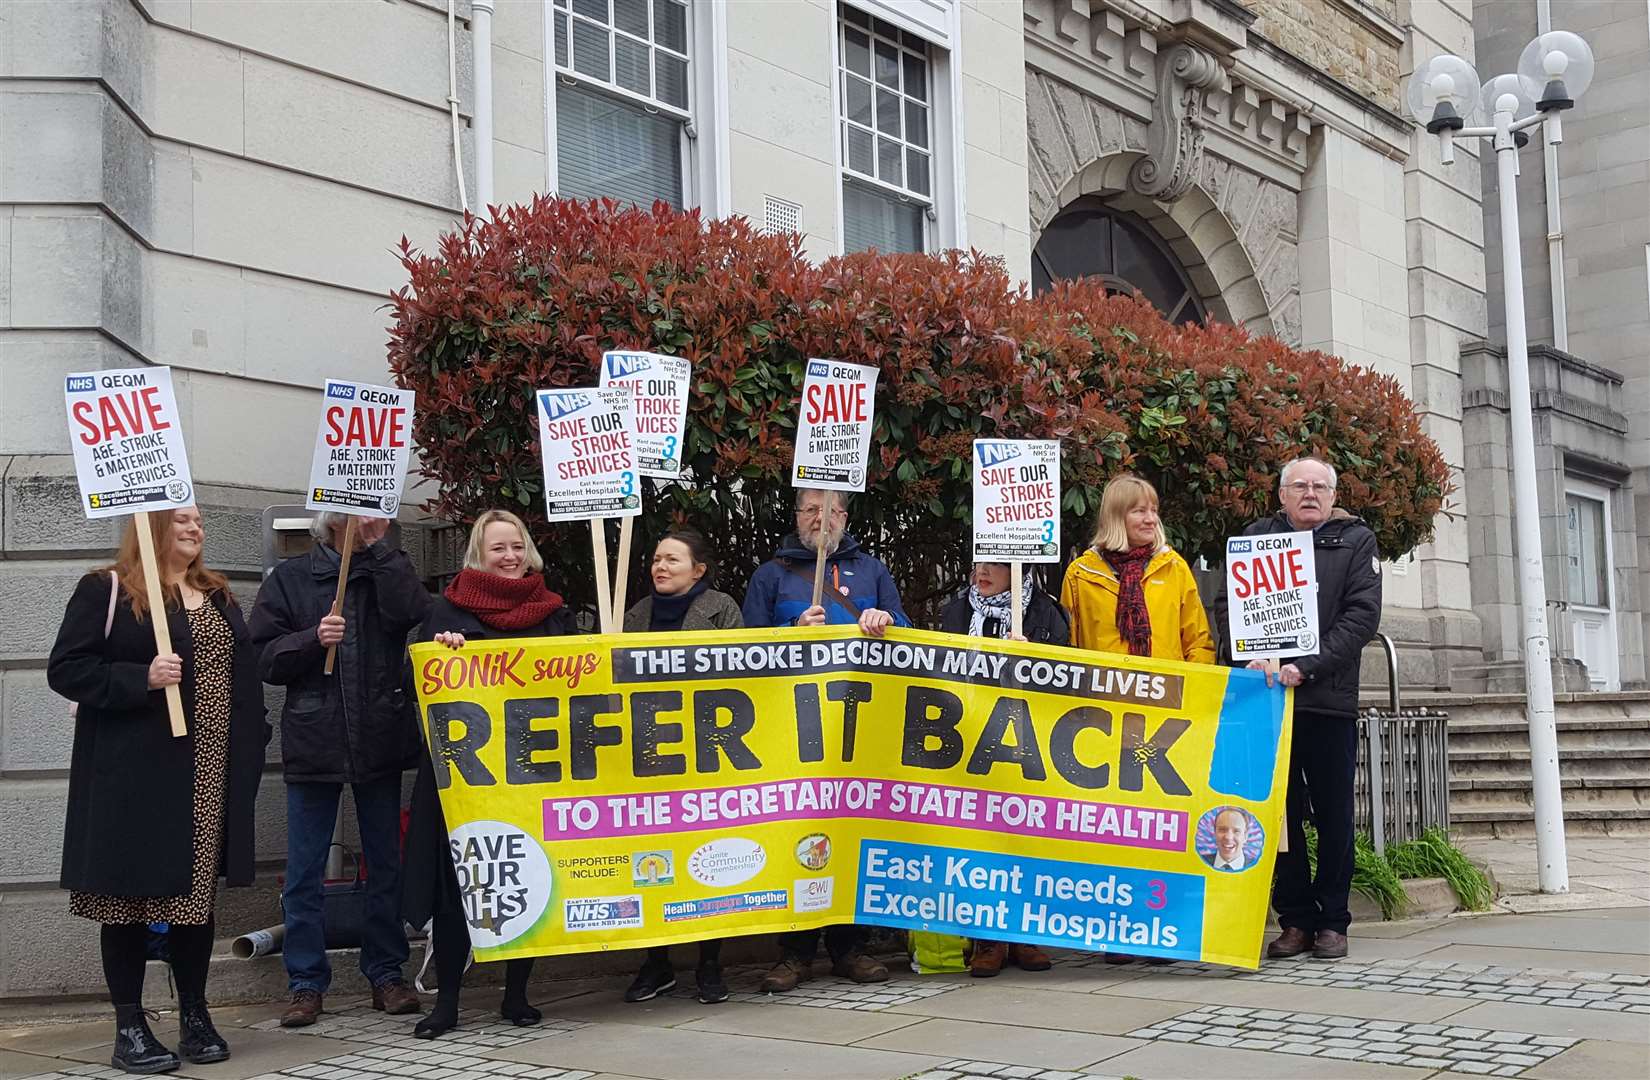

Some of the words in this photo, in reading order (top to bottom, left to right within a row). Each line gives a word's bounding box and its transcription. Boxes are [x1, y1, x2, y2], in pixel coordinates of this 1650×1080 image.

[613, 354, 651, 377] NHS
[659, 358, 674, 366] Save
[663, 365, 678, 374] NHS
[810, 364, 828, 375] NHS
[832, 366, 862, 381] QEQM
[68, 378, 94, 391] NHS
[101, 373, 147, 389] QEQM
[647, 379, 677, 396] OUR
[330, 385, 354, 397] NHS
[360, 389, 400, 406] QEQM
[550, 394, 591, 418] NHS
[806, 383, 867, 425] SAVE
[72, 386, 171, 446] SAVE
[634, 398, 681, 415] TROKE
[325, 405, 406, 447] SAVE
[548, 418, 589, 441] SAVE
[591, 412, 623, 434] OUR
[635, 417, 678, 434] VICES
[810, 425, 830, 439] A&E,
[831, 423, 861, 437] STROKE
[92, 443, 121, 461] A&E,
[120, 432, 166, 454] STROKE
[571, 431, 632, 458] STROKE
[662, 435, 677, 458] 3
[808, 441, 815, 453] &
[816, 437, 860, 452] MATERNITY
[983, 444, 1021, 465] NHS
[94, 464, 105, 478] &
[105, 447, 169, 476] MATERNITY
[330, 448, 354, 463] A&E,
[356, 448, 396, 461] STROKE
[557, 451, 632, 480] SERVICES
[823, 451, 860, 467] SERVICES
[121, 463, 177, 488] SERVICES
[327, 463, 334, 476] &
[337, 463, 396, 476] MATERNITY
[798, 466, 805, 479] 3
[980, 467, 1017, 486] SAVE
[1020, 464, 1049, 483] OUR
[99, 489, 131, 500] Excellent
[131, 487, 164, 497] Hospitals
[346, 478, 395, 491] SERVICES
[548, 489, 583, 498] Excellent
[585, 486, 620, 495] Hospitals
[620, 471, 634, 496] 3
[1000, 482, 1055, 504] STROKE
[90, 495, 100, 508] 3
[100, 499, 111, 507] for
[112, 497, 127, 505] East
[128, 495, 145, 503] Kent
[314, 489, 323, 501] 3
[985, 501, 1054, 524] SERVICES
[975, 532, 1007, 540] Excellent
[1008, 533, 1041, 541] Hospitals
[1041, 520, 1055, 543] 3
[1230, 541, 1250, 552] NHS
[1256, 537, 1293, 551] QEQM
[1231, 549, 1308, 599] SAVE
[1242, 597, 1265, 612] A&E,
[1265, 588, 1303, 607] STROKE
[1243, 614, 1251, 627] &
[1251, 602, 1304, 625] MATERNITY
[1262, 616, 1308, 637] SERVICES
[1236, 640, 1245, 652] 3
[532, 649, 601, 688] says
[630, 649, 686, 675] THE
[694, 644, 804, 673] STROKE
[811, 640, 936, 671] DECISION
[942, 650, 1008, 680] MAY
[1014, 659, 1086, 690] COST
[1091, 669, 1166, 700] LIVES
[426, 688, 763, 790] REFER
[793, 680, 873, 763] IT
[900, 685, 1193, 797] BACK
[552, 799, 599, 832] TO
[608, 793, 672, 828] THE
[681, 780, 846, 824] SECRETARY
[845, 781, 884, 810] OF
[889, 783, 978, 820] STATE
[986, 794, 1046, 829] FOR
[1055, 801, 1179, 842] HEALTH
[450, 833, 526, 864] SAVE
[709, 851, 728, 859] unite
[557, 855, 630, 869] SUPPORTERS
[701, 852, 766, 868] Community
[711, 862, 756, 873] membership
[457, 861, 521, 893] OUR
[570, 867, 620, 879] INCLUDE:
[865, 847, 934, 884] East
[944, 855, 1023, 893] Kent
[1035, 872, 1133, 907] needs
[1145, 878, 1168, 910] 3
[568, 903, 610, 922] NHS
[664, 902, 697, 915] Health
[743, 892, 787, 906] Together
[618, 918, 640, 926] public
[863, 883, 1009, 927] Excellent
[1020, 901, 1180, 948] Hospitals
